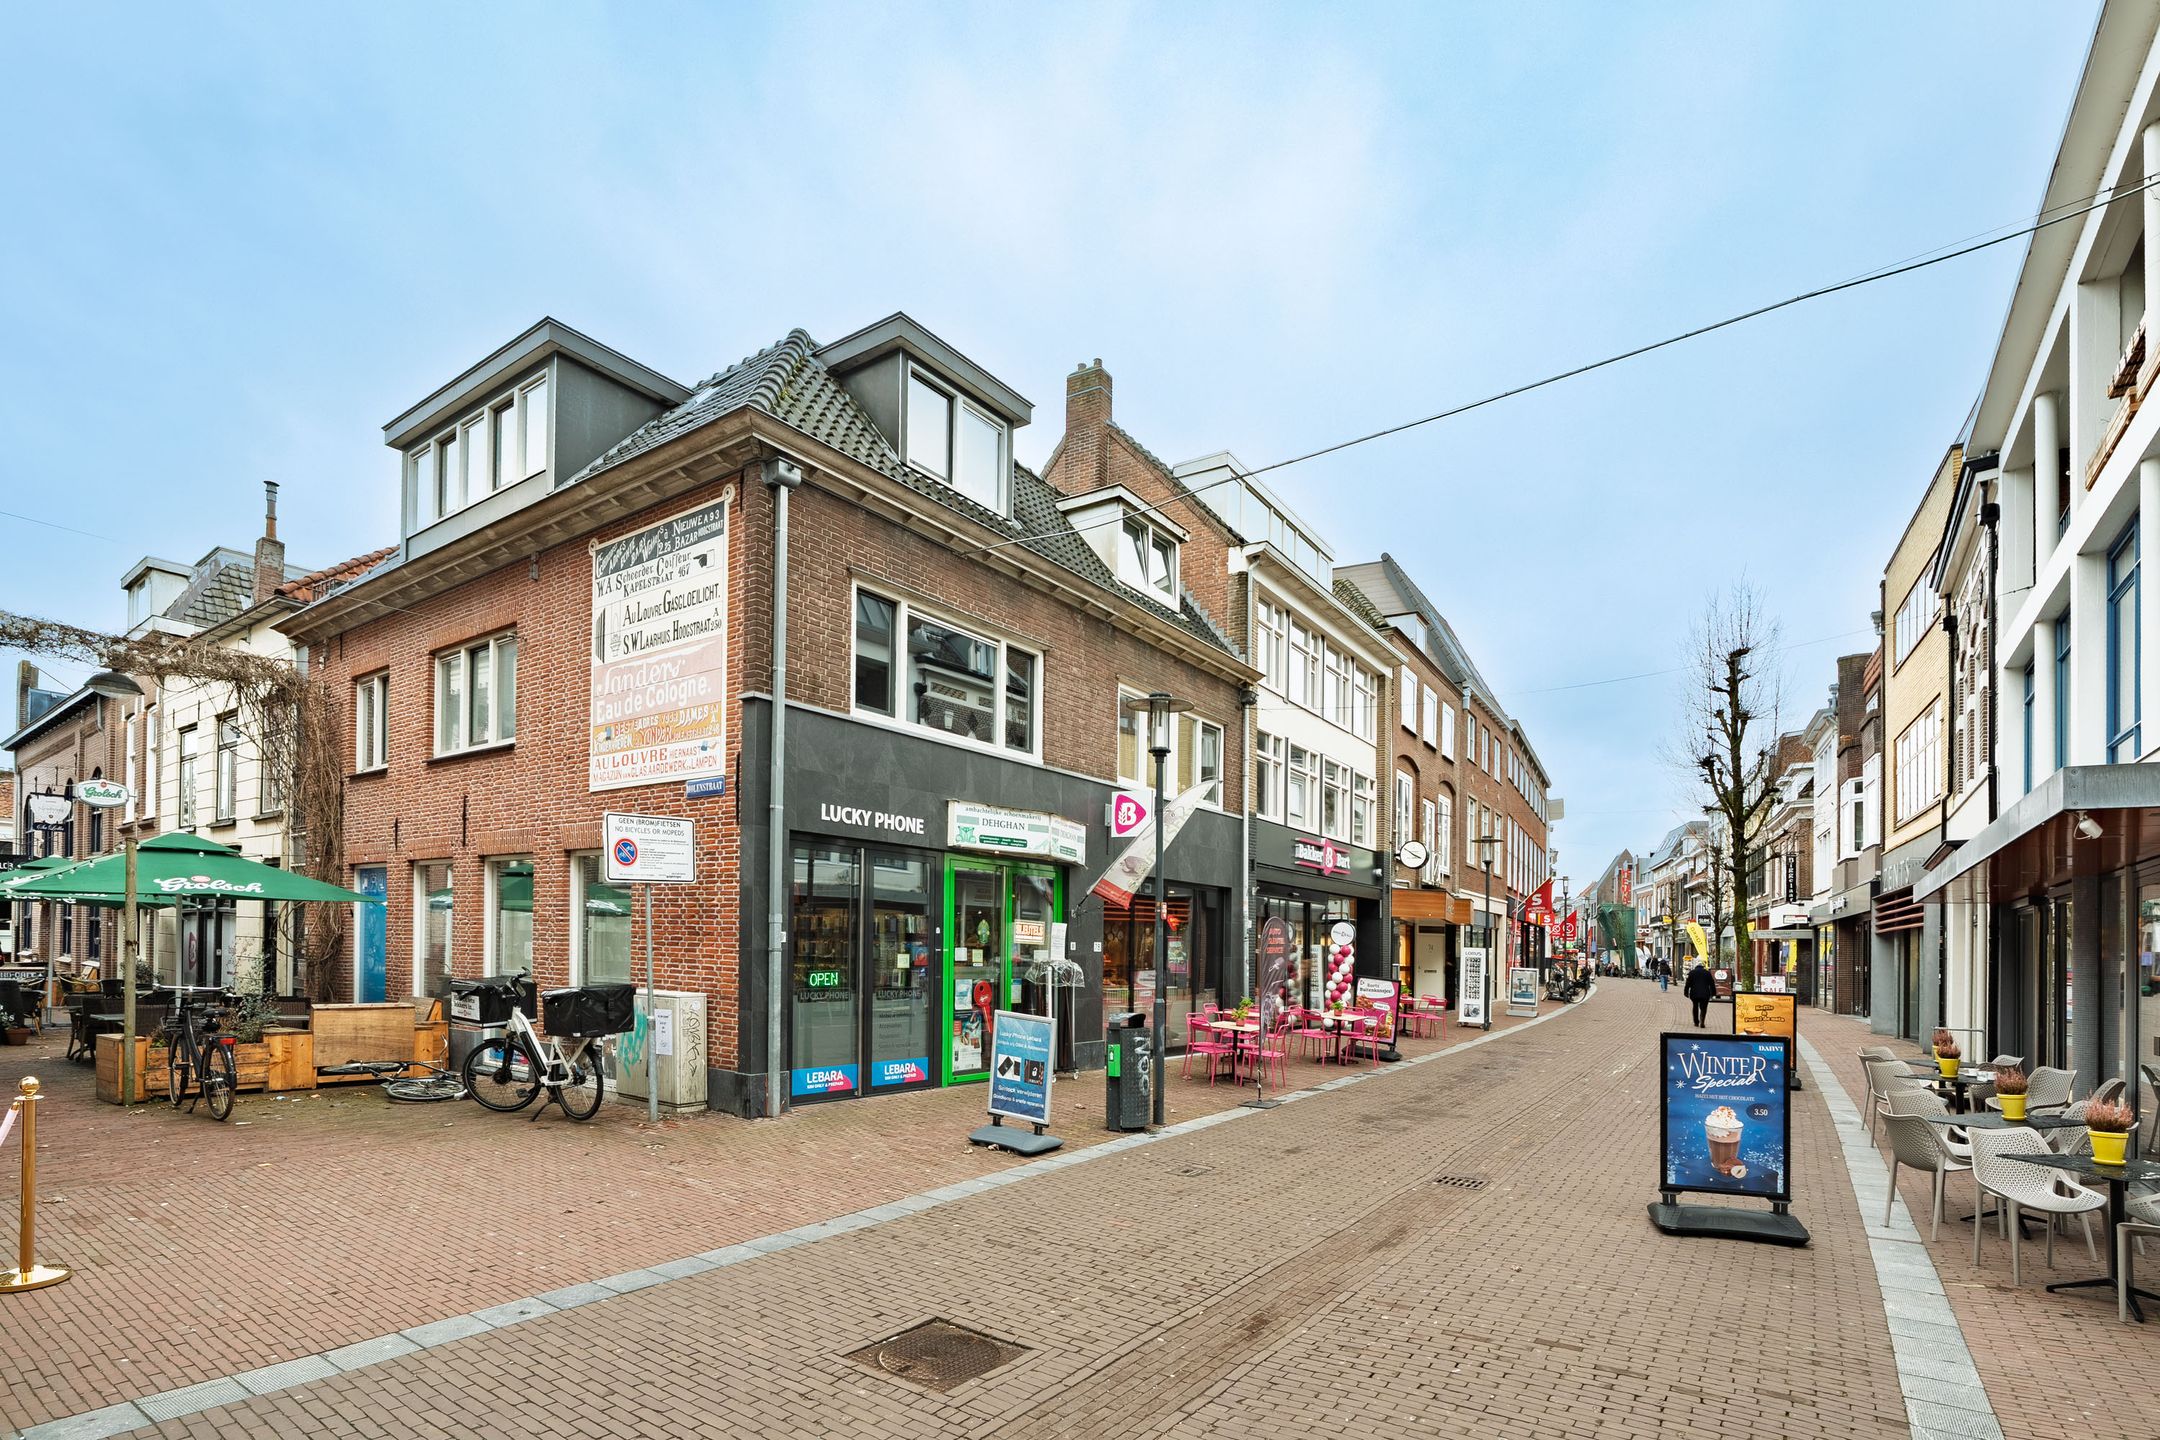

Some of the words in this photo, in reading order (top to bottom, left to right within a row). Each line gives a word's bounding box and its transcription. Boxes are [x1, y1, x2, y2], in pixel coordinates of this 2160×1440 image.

[673, 531, 698, 552] BAZAR
[596, 700, 622, 723] Eau
[624, 692, 643, 715] de
[612, 747, 668, 768] LOUVRE
[84, 786, 122, 798] Grolsch
[618, 817, 635, 825] GEEN
[821, 802, 873, 827] LUCKY
[874, 811, 925, 835] PHONE
[981, 818, 1026, 831] DEHGHAN
[625, 826, 651, 834] BICYCLES
[662, 829, 685, 837] MOPEDS
[153, 877, 264, 894] Grolsch
[1531, 893, 1543, 906] S
[809, 972, 839, 987] OPEN
[885, 1062, 917, 1076] LEBARA
[1677, 1051, 1768, 1083] WINTER
[806, 1070, 844, 1084] LEBARA
[1691, 1073, 1758, 1093] Special
[1754, 1108, 1769, 1116] 3.50
